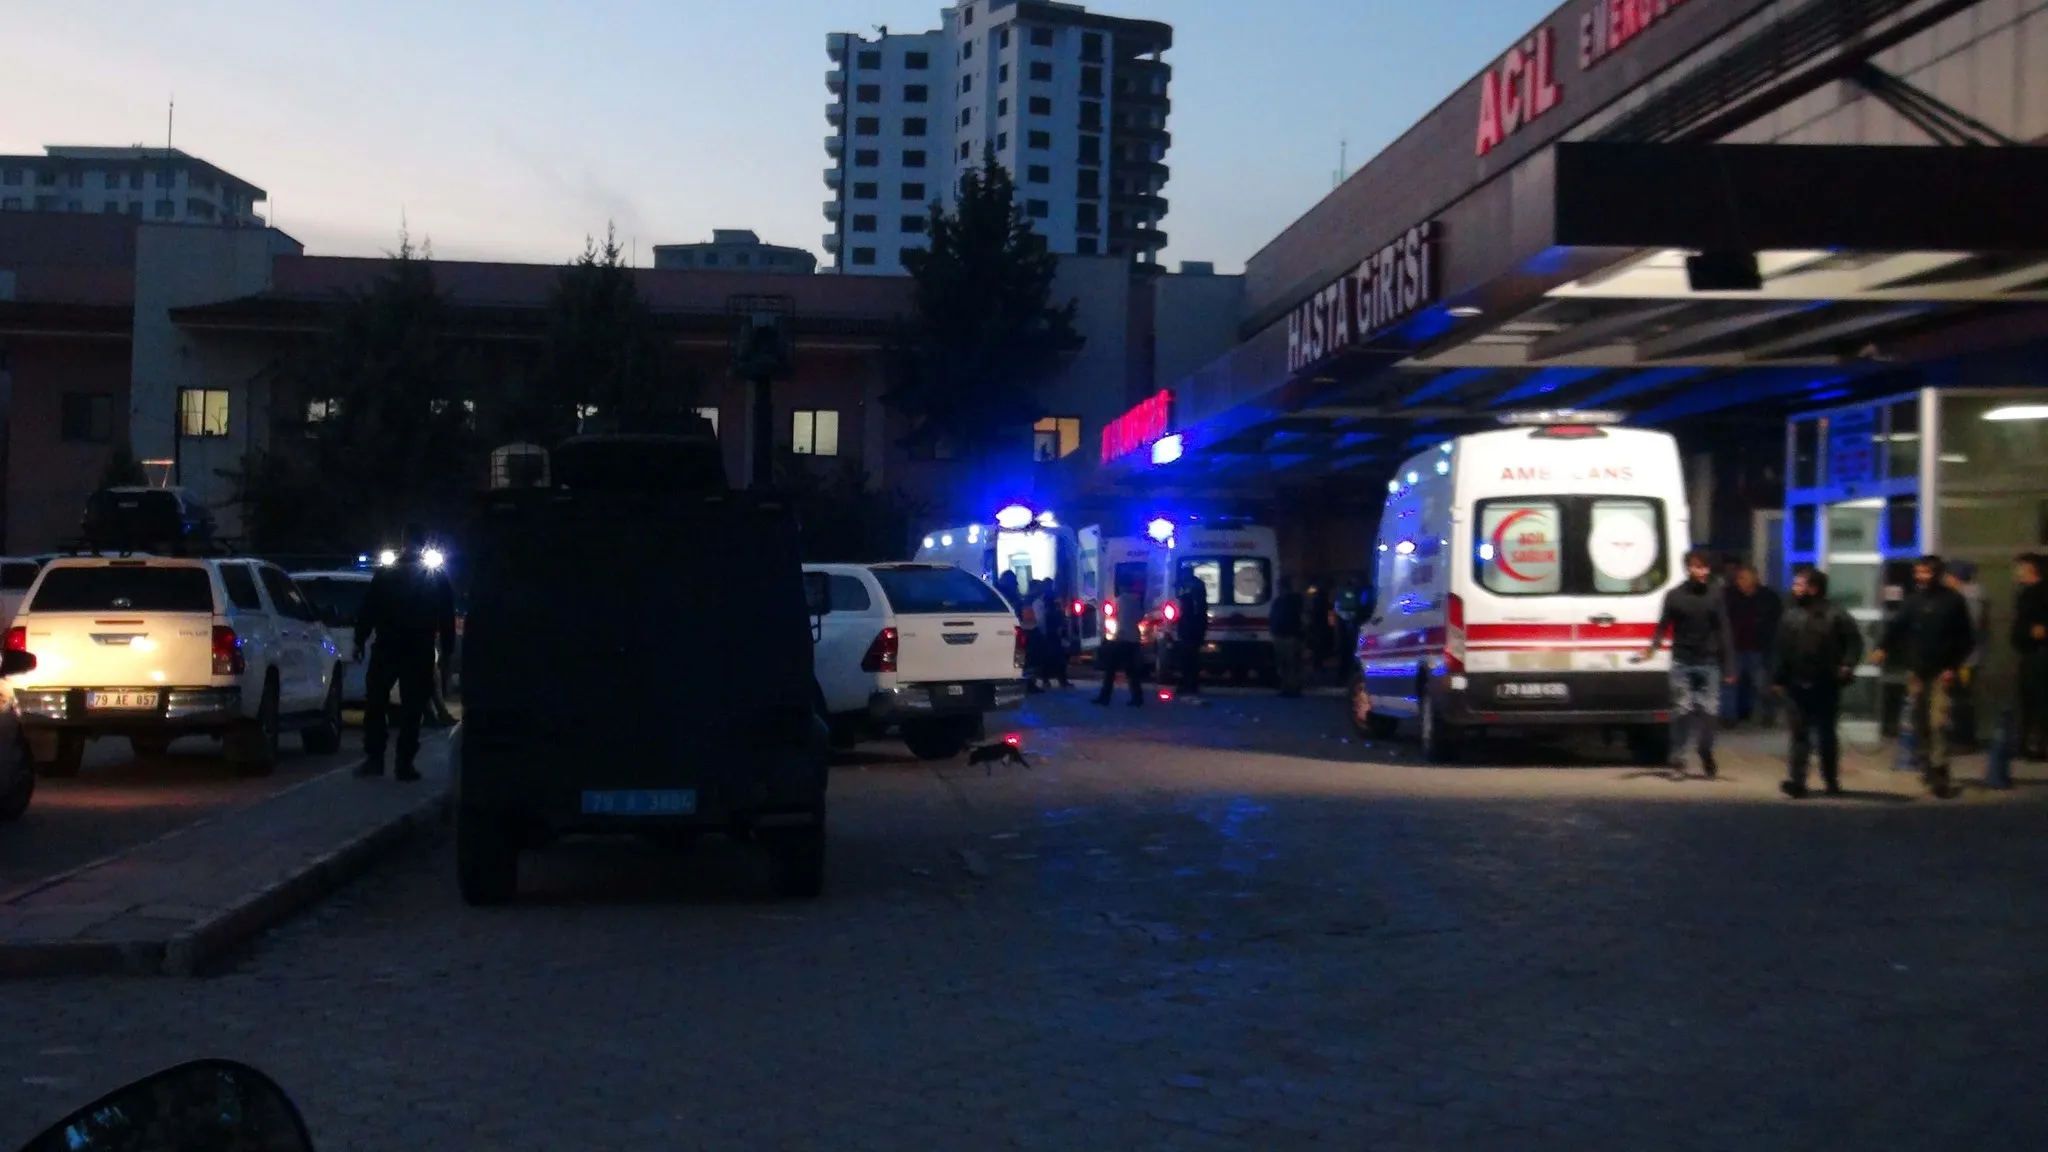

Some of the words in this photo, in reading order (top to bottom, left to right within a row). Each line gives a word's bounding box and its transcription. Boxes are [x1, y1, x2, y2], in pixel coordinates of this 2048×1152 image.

[1288, 277, 1349, 373] HASTA
[1500, 467, 1633, 481] AMBANS
[95, 694, 108, 706] 79
[115, 694, 129, 706] AE
[593, 794, 613, 812] 79
